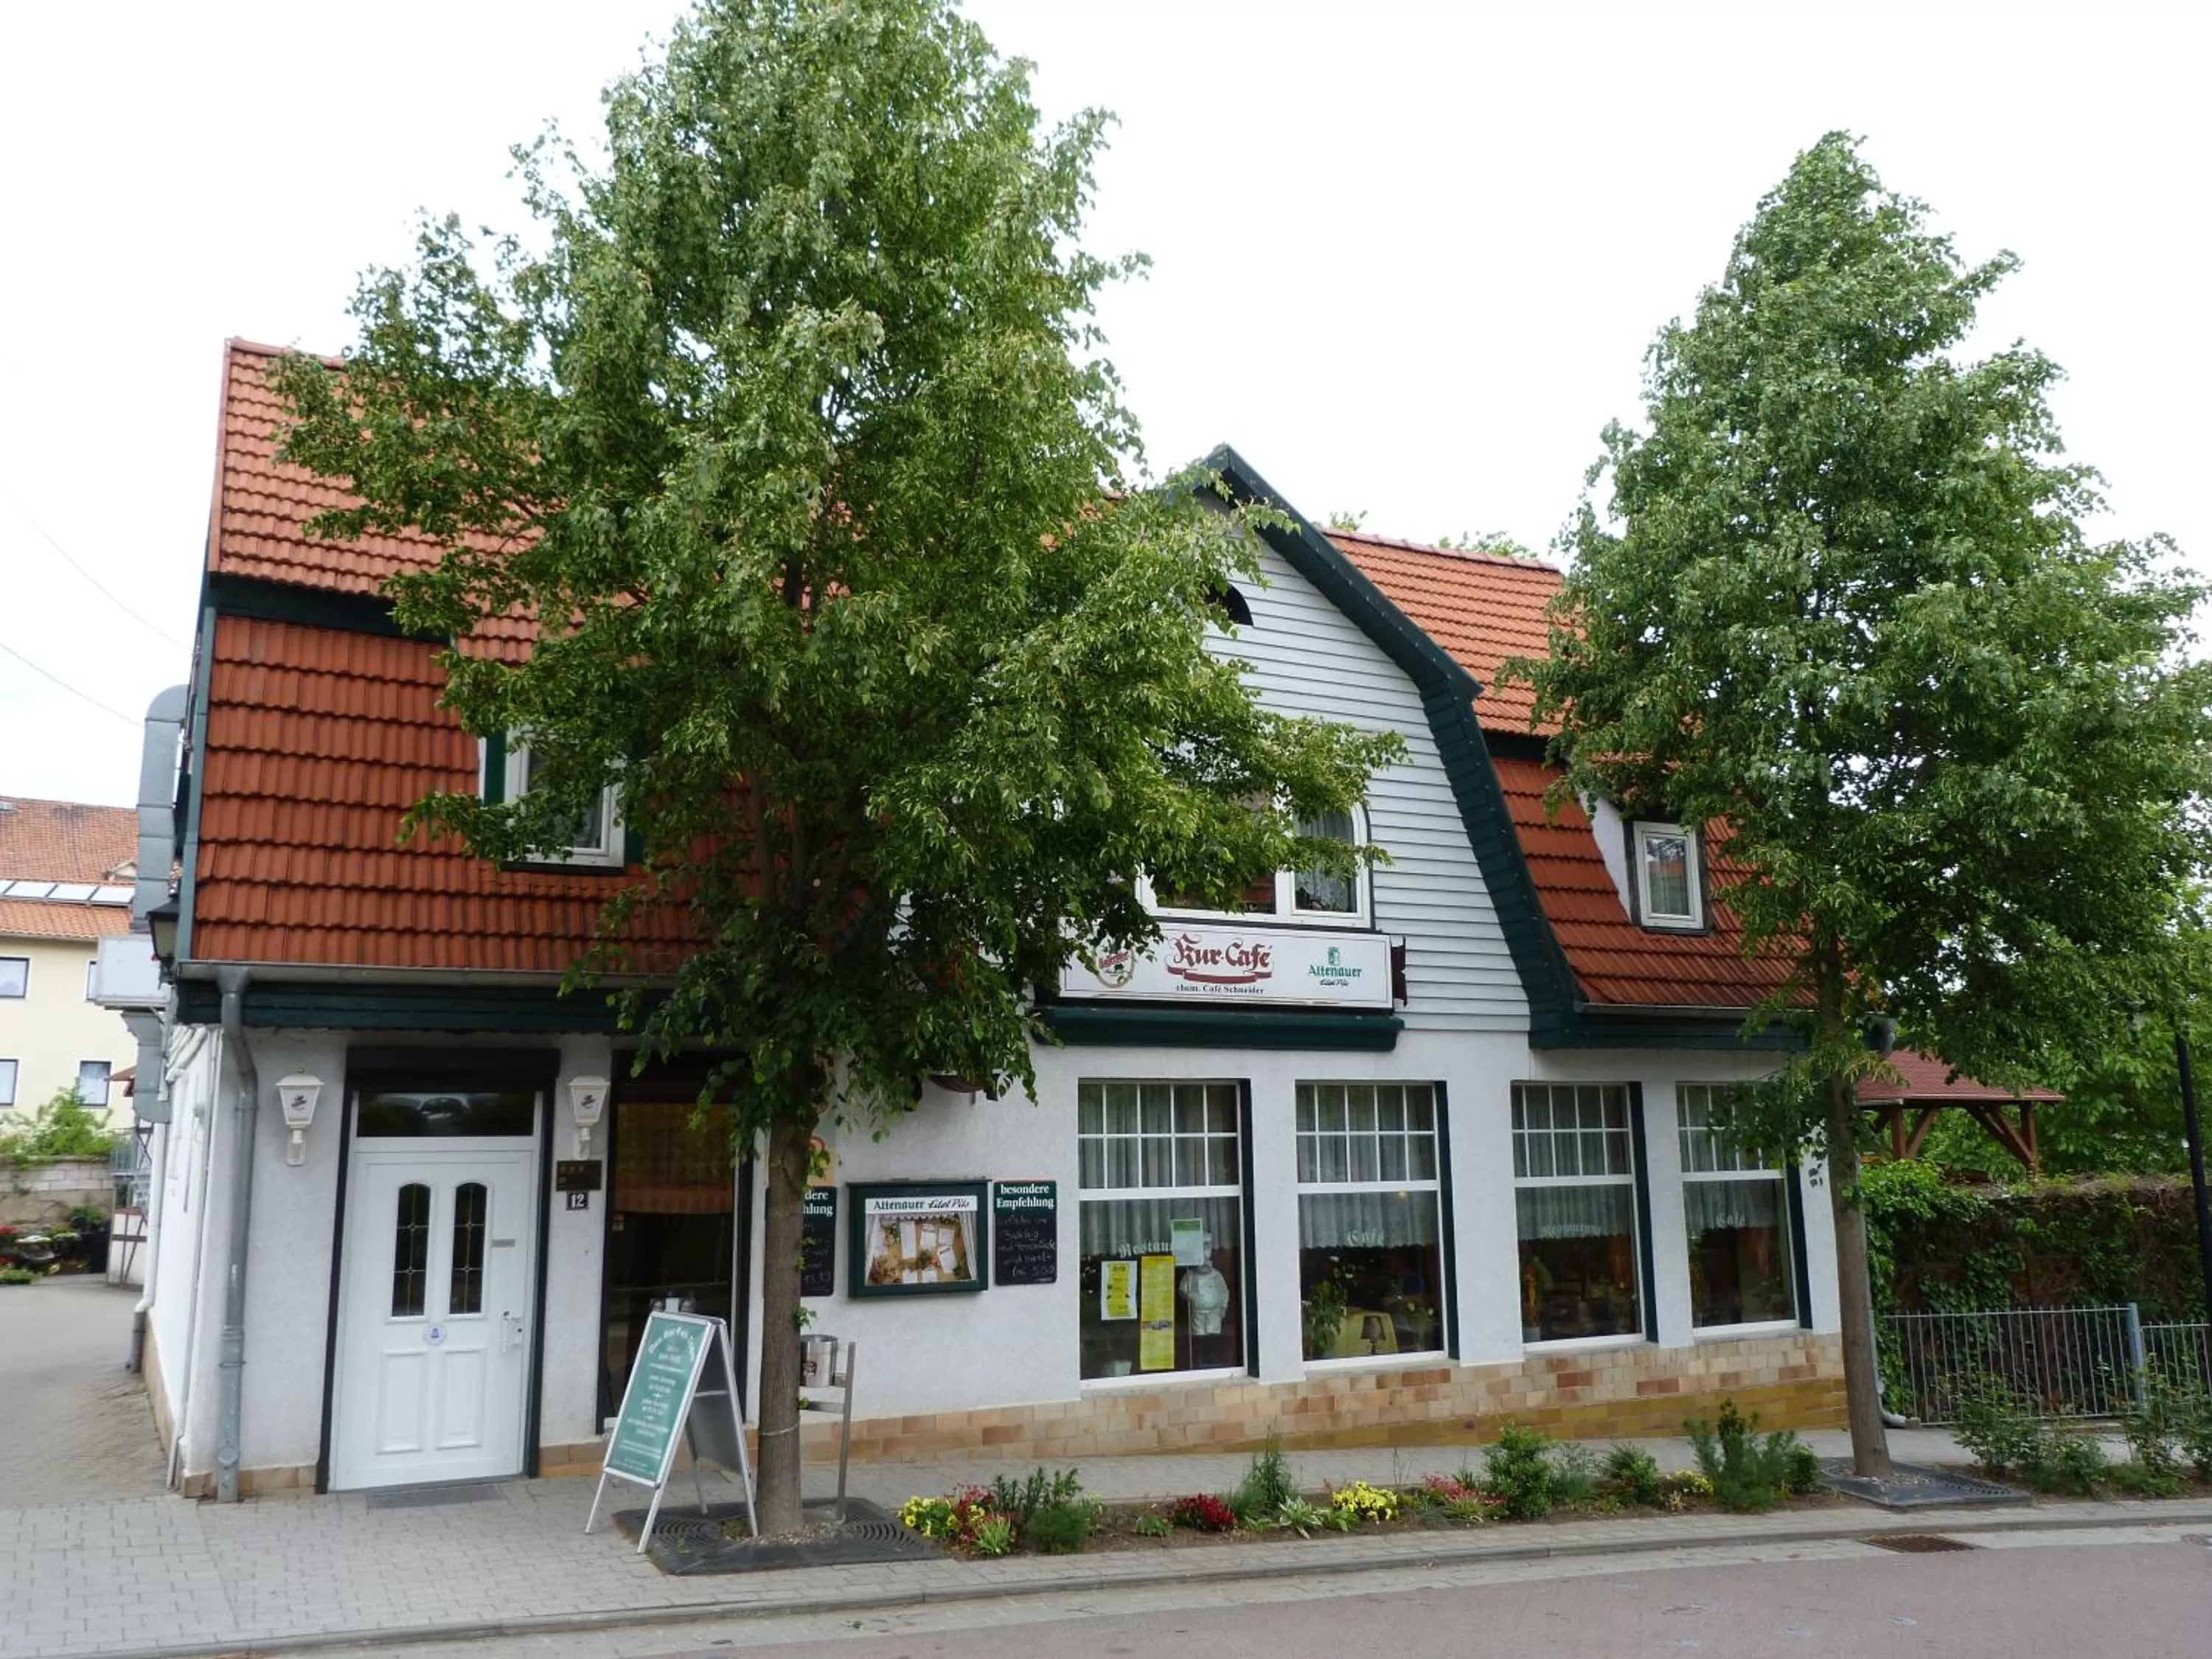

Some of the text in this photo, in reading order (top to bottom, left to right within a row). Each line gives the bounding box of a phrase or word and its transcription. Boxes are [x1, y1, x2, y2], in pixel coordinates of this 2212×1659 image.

[1169, 933, 1273, 974] Kur-Café
[1309, 964, 1363, 978] Altenauer
[1223, 985, 1264, 994] Schneider
[1001, 1183, 1049, 1194] besondere
[570, 1194, 585, 1208] 12
[874, 1200, 925, 1210] Altenauer
[996, 1196, 1055, 1210] Empfehlung
